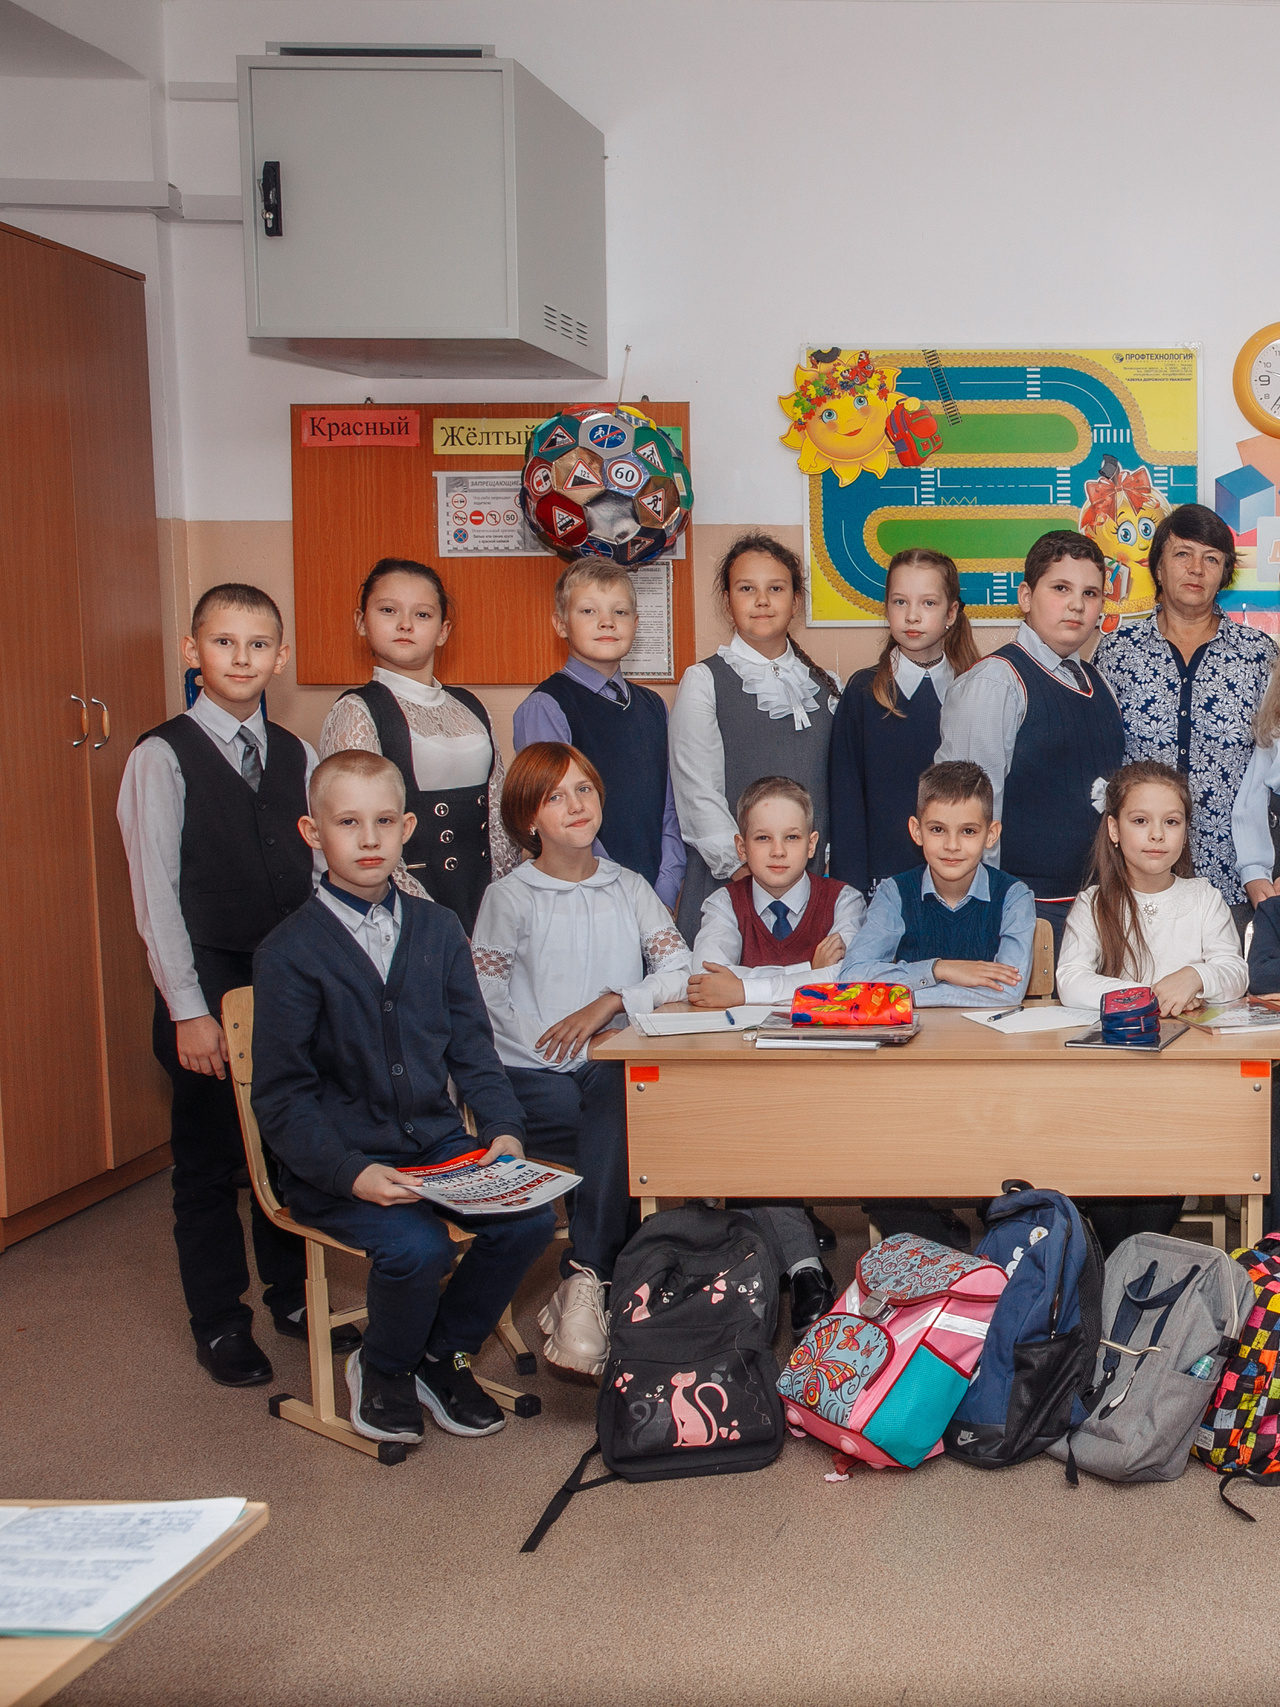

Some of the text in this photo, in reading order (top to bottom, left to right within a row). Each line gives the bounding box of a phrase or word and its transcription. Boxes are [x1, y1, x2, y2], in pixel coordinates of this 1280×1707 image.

[1125, 353, 1193, 361] ПРОФТЕХНОЛОГИЯ
[1258, 374, 1271, 387] 9
[309, 416, 411, 440] Красный
[441, 425, 533, 448] Жёлтый
[614, 467, 635, 483] 60
[471, 480, 519, 488] ЗАПРЕЩАЮЩИЕ
[422, 1162, 503, 1188] ПРАКТИКУ
[438, 1169, 534, 1197] ПРОВЕРОЧНАЯ
[485, 1172, 499, 1180] 3
[445, 1171, 540, 1200] ВСЕРОССИЙСКАЯ
[456, 1177, 506, 1194] РАБОТА
[457, 1172, 552, 1204] МАТЕМАТИКА
[960, 1429, 974, 1441] NIKE
